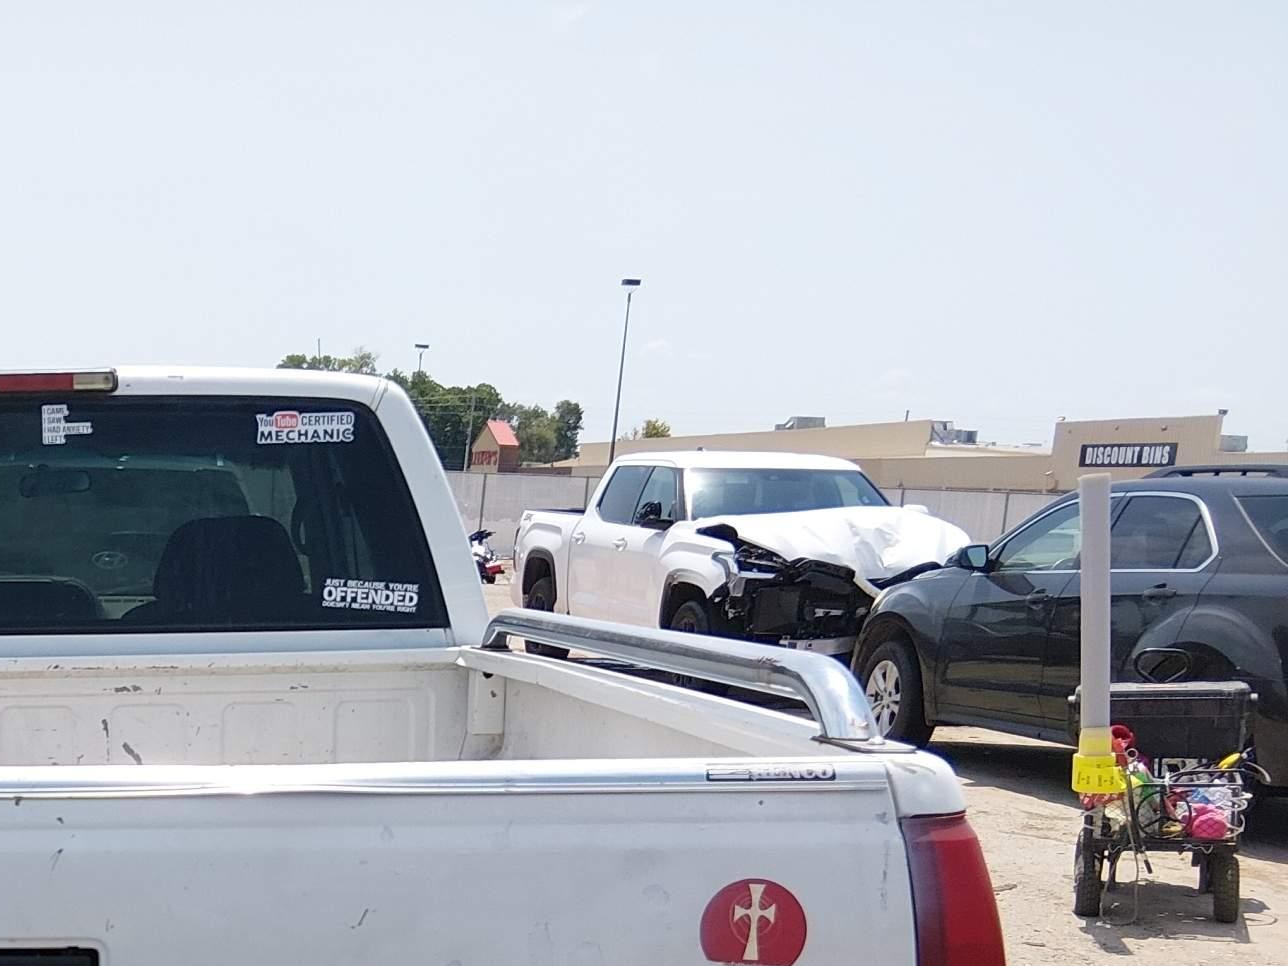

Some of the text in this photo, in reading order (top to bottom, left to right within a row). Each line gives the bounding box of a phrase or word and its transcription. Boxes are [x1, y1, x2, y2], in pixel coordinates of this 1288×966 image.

[301, 414, 353, 426] CERTIFIED
[259, 428, 353, 441] MECHANIC
[1085, 445, 1170, 464] DISCOUNT BINS
[325, 578, 419, 592] JUST BECAUSE YOU'RE
[323, 586, 418, 606] OFFENDED
